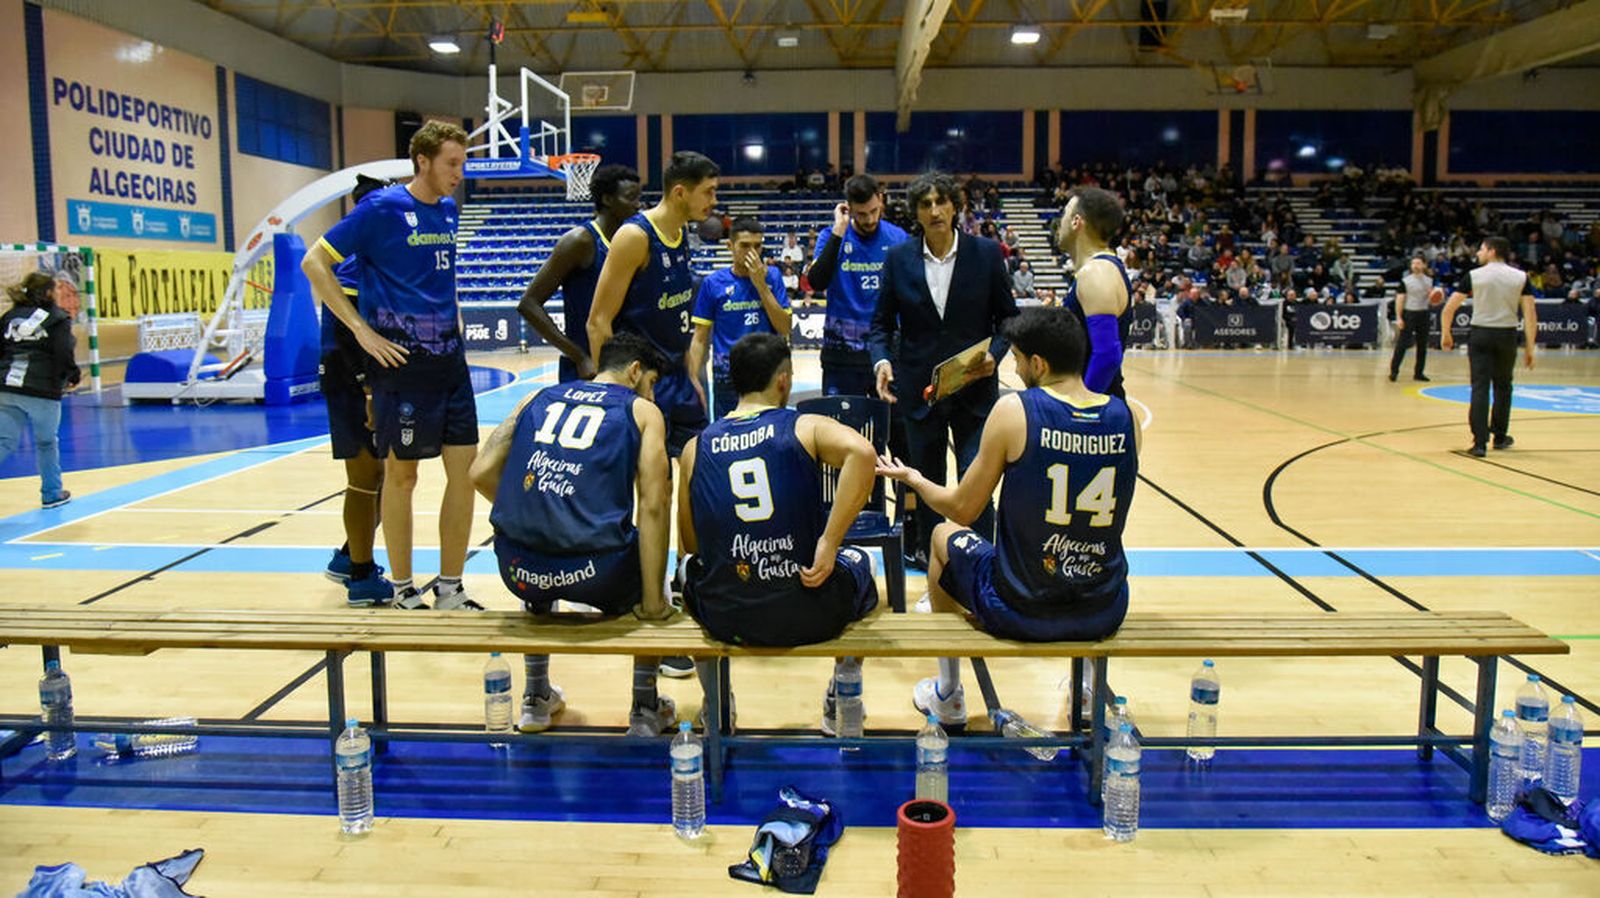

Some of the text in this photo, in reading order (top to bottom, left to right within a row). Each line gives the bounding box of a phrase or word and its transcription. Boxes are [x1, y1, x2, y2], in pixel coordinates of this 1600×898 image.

[53, 77, 212, 140] POLIDEPORTIVO
[89, 127, 195, 169] CIUDAD DE
[89, 168, 197, 205] ALGECIRAS
[434, 250, 450, 270] 15
[861, 275, 880, 290] 23
[744, 312, 760, 326] 26
[1213, 327, 1257, 337] ASESORES
[1332, 309, 1361, 329] ice
[1516, 318, 1579, 332] dmex.io
[466, 327, 490, 341] PSOE
[564, 388, 607, 403] LOPEZ
[534, 401, 606, 450] 10
[711, 424, 775, 454] CÓRDOBA
[1041, 427, 1126, 455] RODRIGUEZ
[527, 449, 583, 476] Algeciras
[538, 471, 576, 497] Gusta
[728, 456, 775, 523] 9
[1044, 463, 1117, 528] 14
[730, 533, 794, 565] Algeciras
[1042, 533, 1106, 562] Algeciras
[516, 559, 597, 590] magicland
[758, 557, 801, 580] Gusta
[1062, 556, 1103, 579] Gusta
